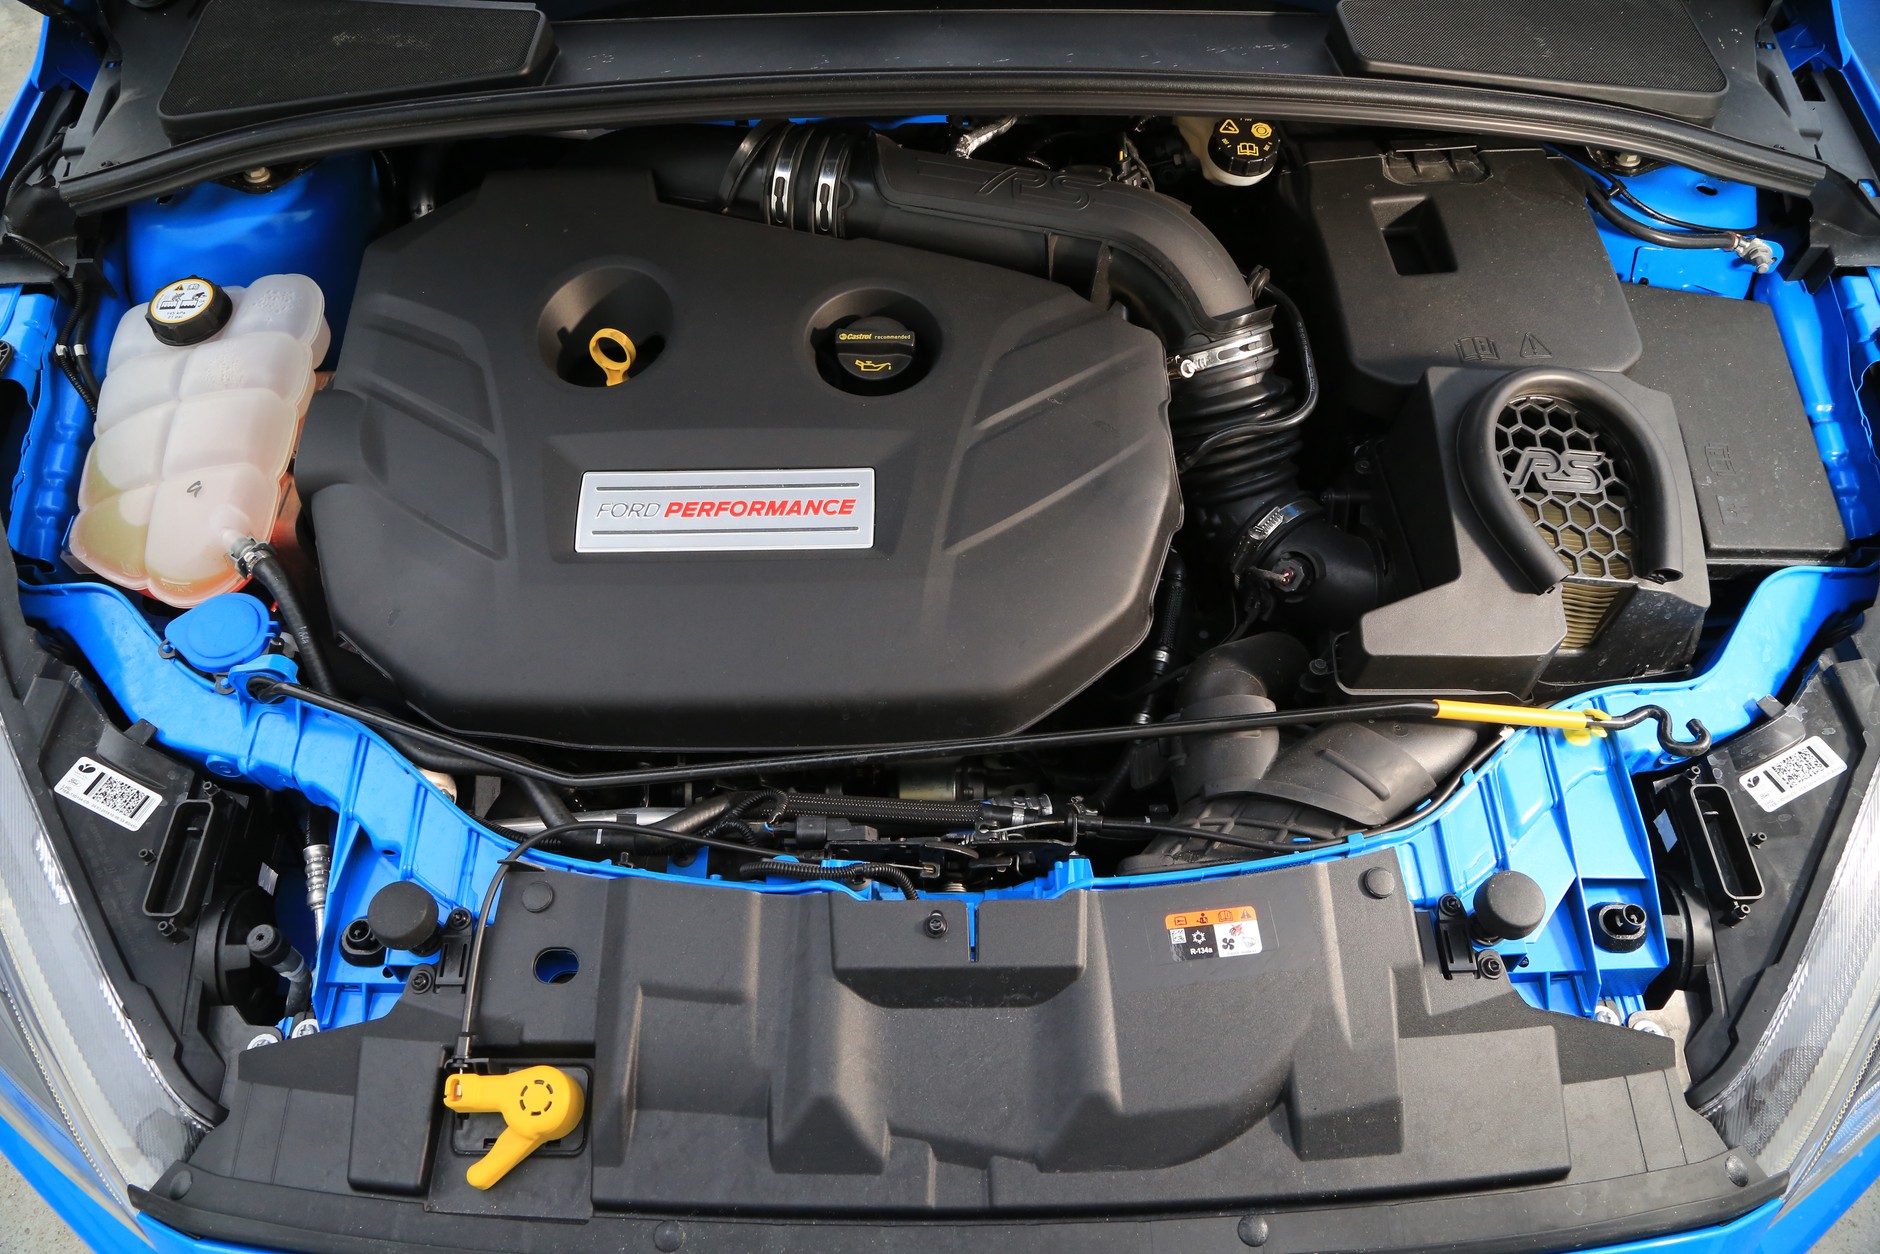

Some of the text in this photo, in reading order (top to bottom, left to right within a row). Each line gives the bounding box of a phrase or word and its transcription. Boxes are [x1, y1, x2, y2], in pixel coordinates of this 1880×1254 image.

[1508, 446, 1606, 495] RS
[595, 499, 857, 518] FORD PERFORMANCE
[1190, 947, 1213, 955] R-134a
